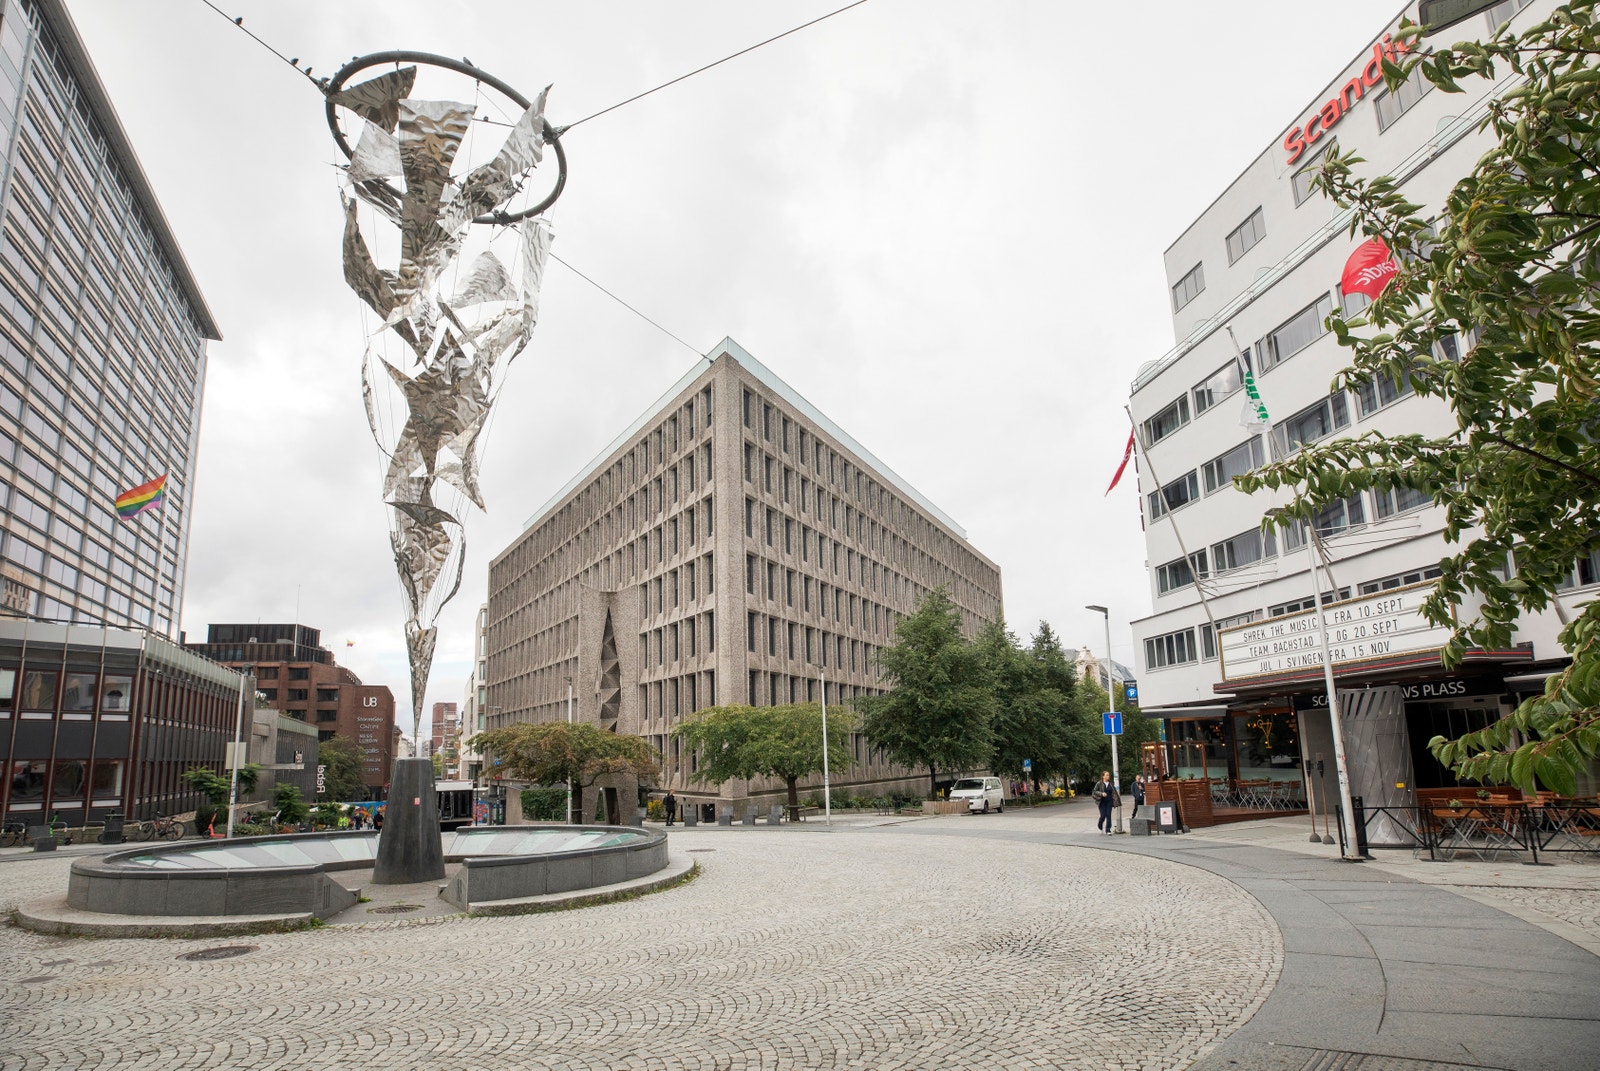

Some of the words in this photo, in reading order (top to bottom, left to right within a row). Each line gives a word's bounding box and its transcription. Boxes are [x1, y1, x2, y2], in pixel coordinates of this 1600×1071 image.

[1283, 20, 1417, 166] Scandic
[1243, 629, 1266, 642] SHREK
[1270, 624, 1284, 636] THE
[1290, 615, 1328, 632] MUSICL
[1334, 610, 1352, 623] FRA
[1249, 644, 1269, 657] TEAM
[1259, 661, 1272, 672] JUL
[1287, 652, 1324, 668] SVINGEN
[1328, 649, 1346, 661] FRA
[1422, 681, 1466, 696] PLASS
[363, 696, 378, 708] U8
[316, 764, 327, 793] Rebel
